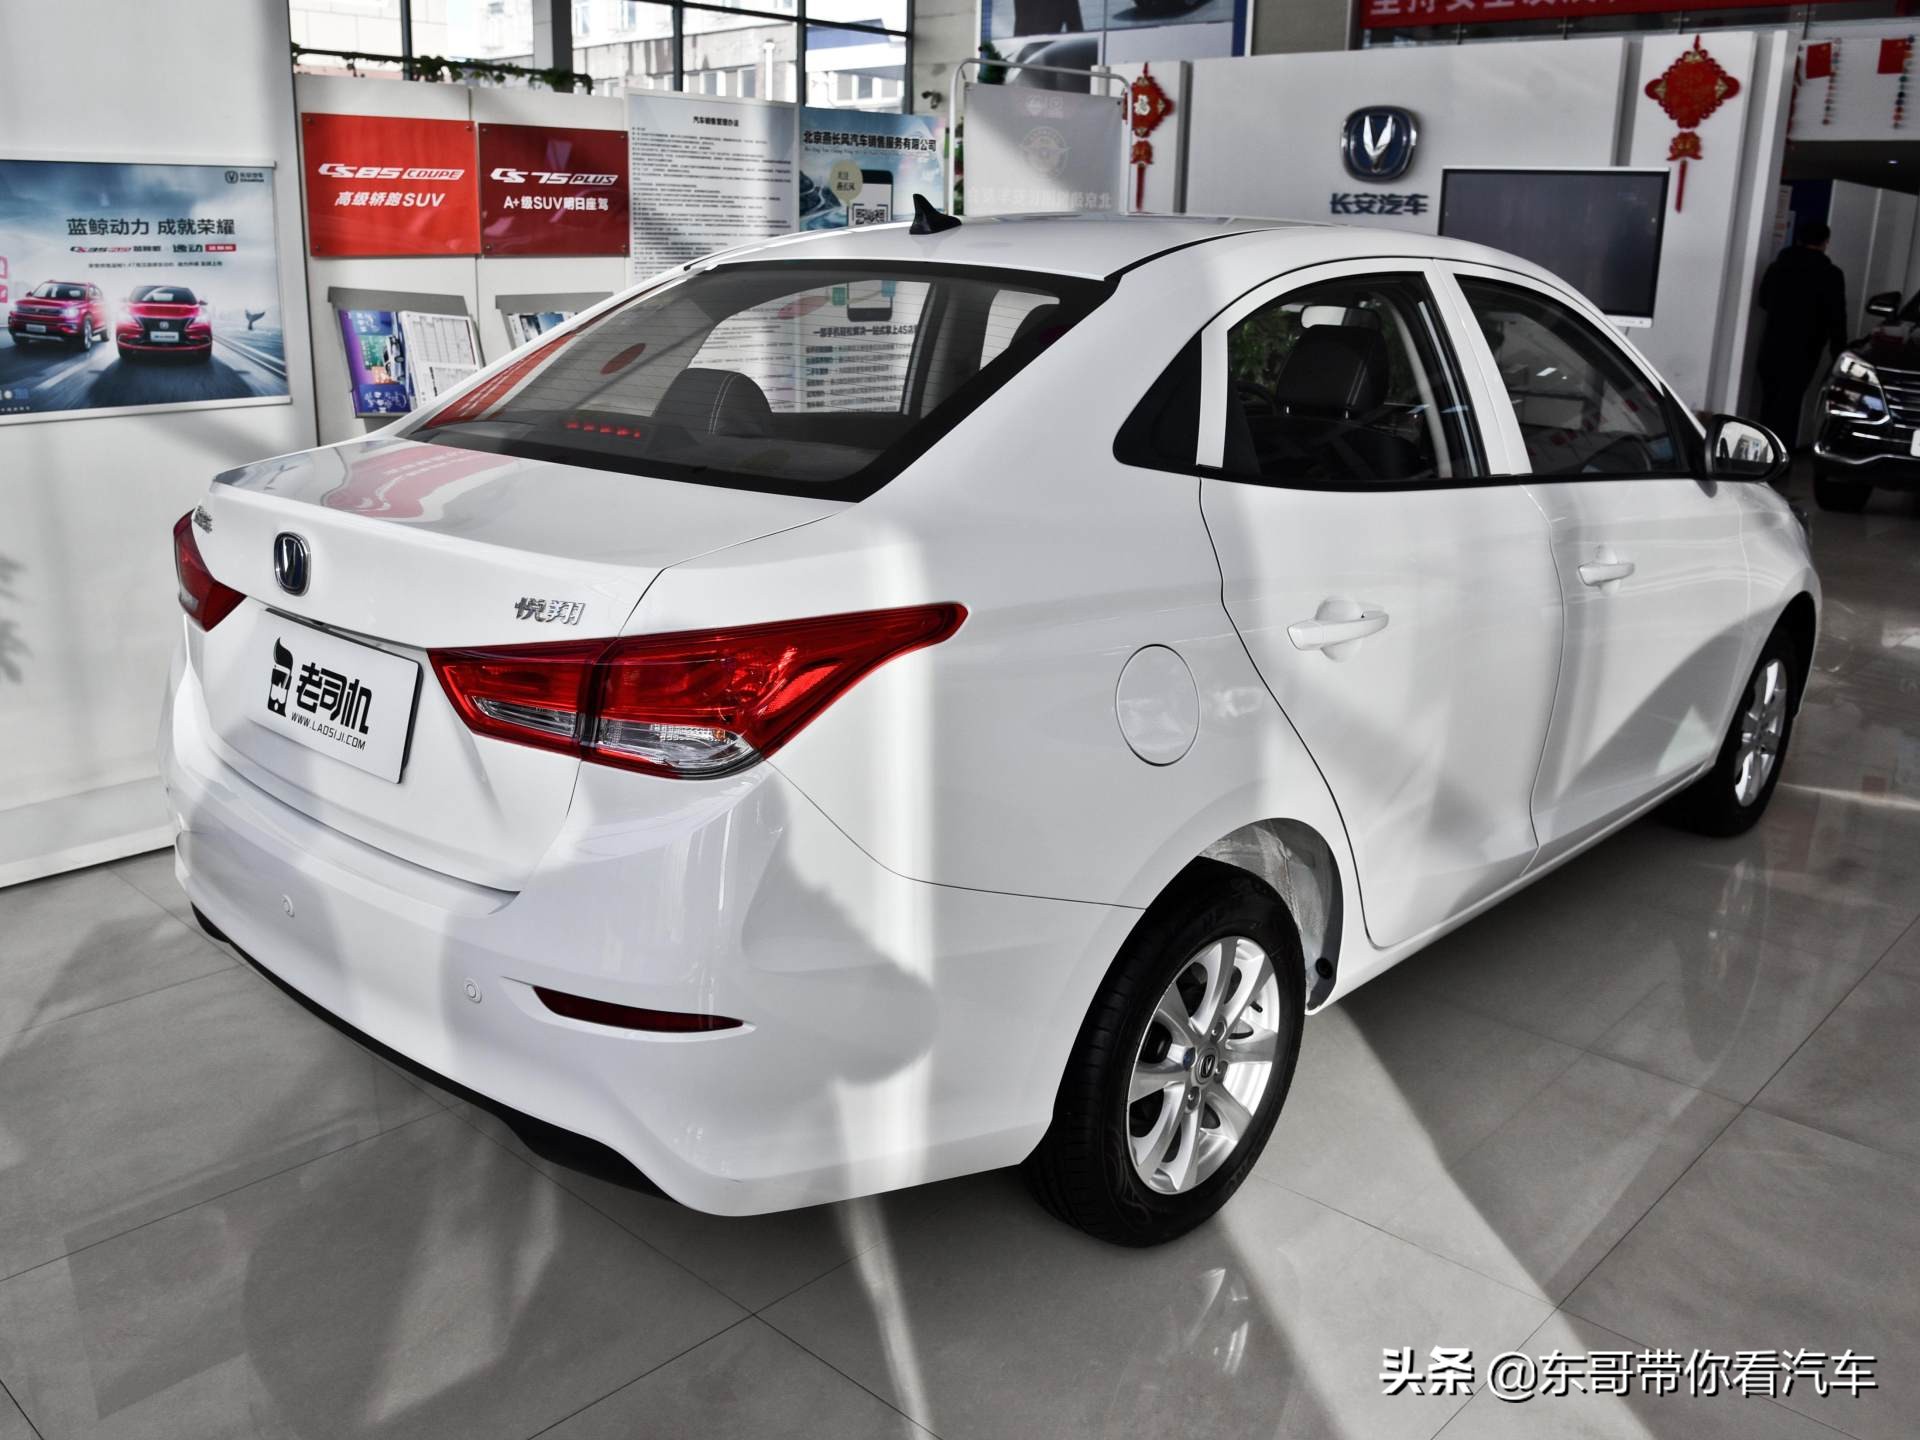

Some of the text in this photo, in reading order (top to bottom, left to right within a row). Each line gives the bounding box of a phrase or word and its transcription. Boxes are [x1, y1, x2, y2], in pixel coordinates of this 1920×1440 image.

[318, 163, 462, 180] CS85 COUPE
[572, 174, 616, 185] PLUS
[334, 190, 445, 208] 高级轿跑SUV
[503, 195, 609, 211] A+级SUV明日座驾
[1330, 192, 1429, 215] 长安汽车
[67, 218, 236, 236] 蓝鲸动力 成就荣耀
[514, 597, 586, 625] 悦翔
[296, 662, 372, 735] 老司机
[291, 711, 366, 751] WWW.LAOSIJI.COM
